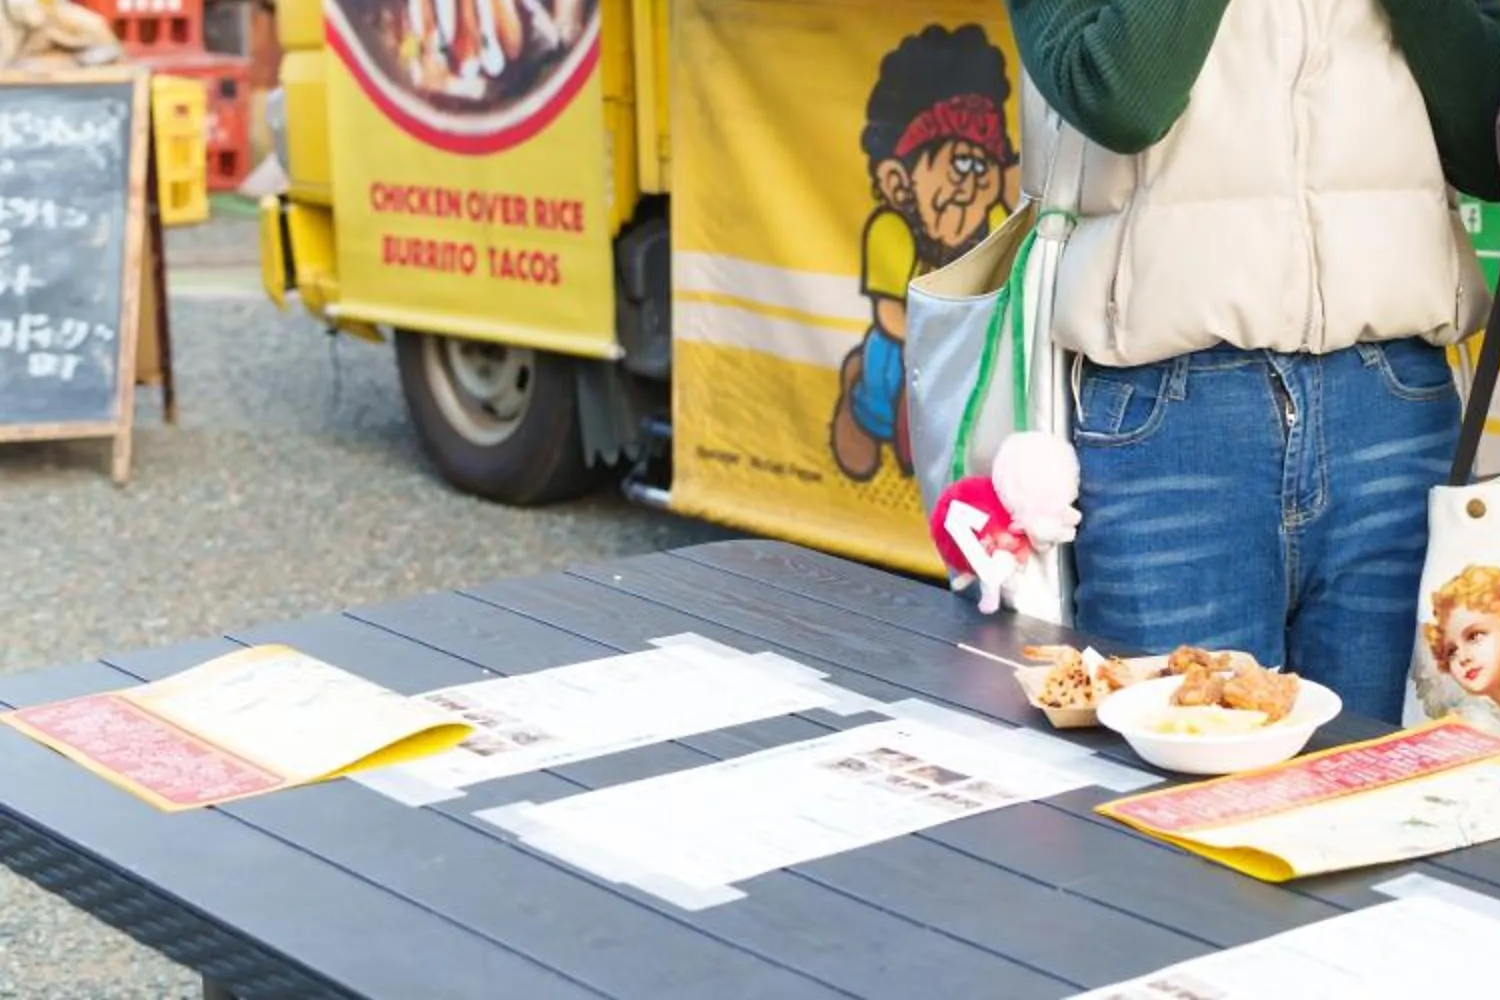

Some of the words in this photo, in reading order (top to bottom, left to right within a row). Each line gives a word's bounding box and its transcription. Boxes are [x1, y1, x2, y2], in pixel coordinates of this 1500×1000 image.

[370, 181, 463, 219] CHICKEN
[466, 192, 528, 227] OVER
[533, 196, 583, 233] RICE
[382, 234, 477, 275] BURRITO
[488, 246, 560, 286] TACOS
